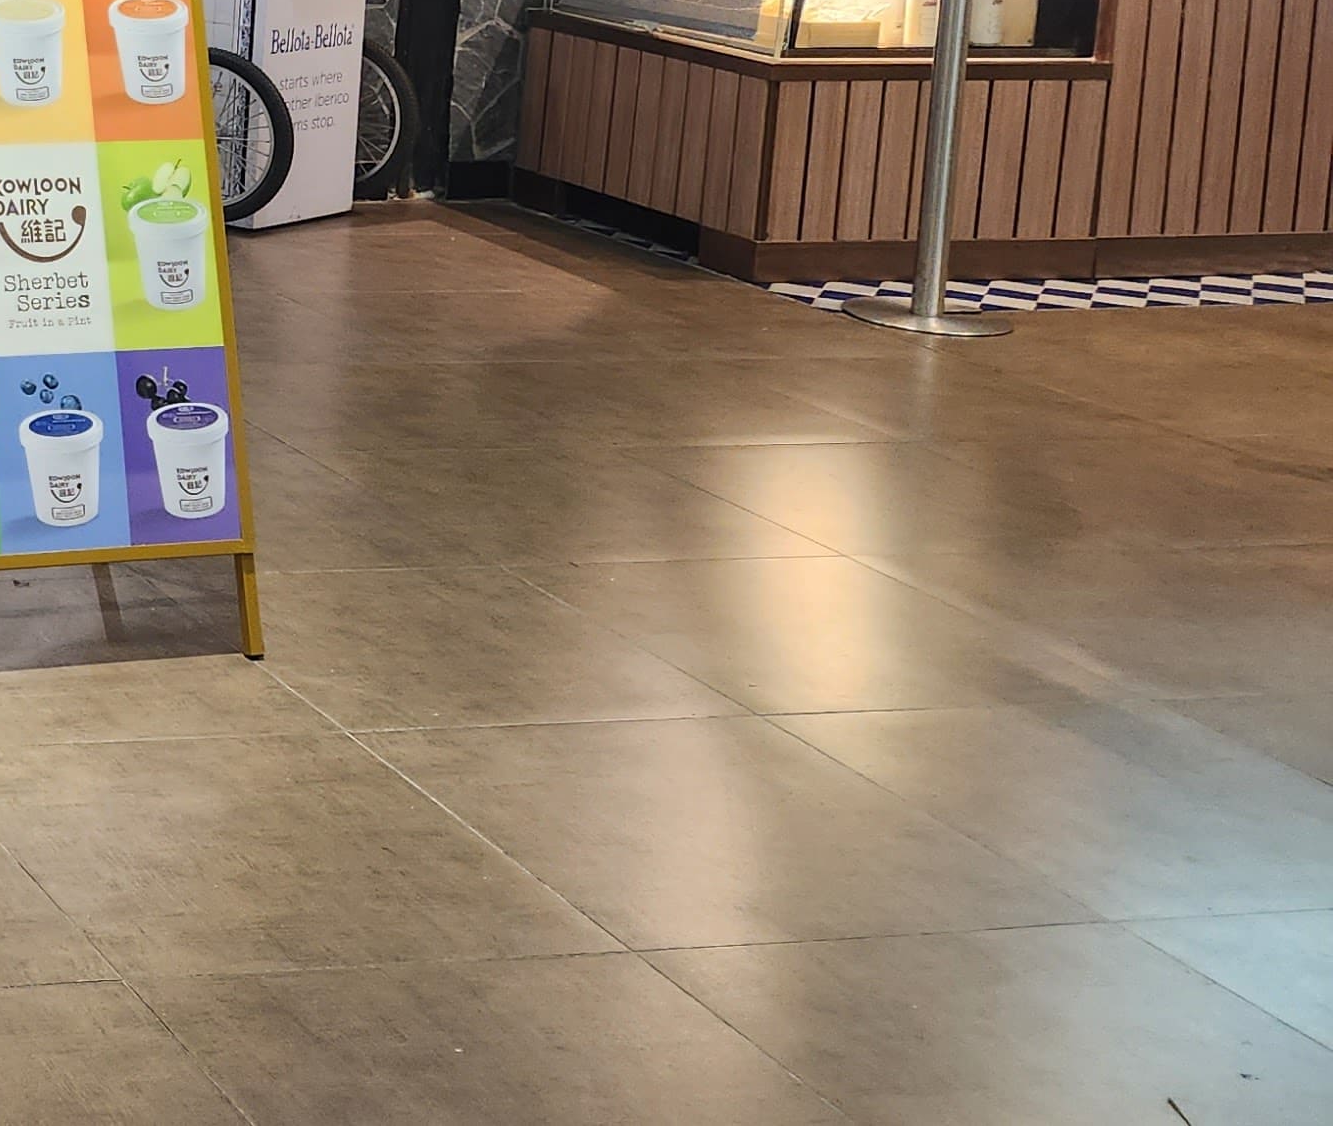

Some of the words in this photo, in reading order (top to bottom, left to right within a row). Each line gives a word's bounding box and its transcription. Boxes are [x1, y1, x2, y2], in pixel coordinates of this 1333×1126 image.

[279, 76, 309, 91] starts
[312, 72, 343, 86] where
[20, 218, 67, 244] 維記
[3, 271, 90, 294] Sherbet
[16, 291, 91, 312] Series
[42, 317, 54, 328] in
[57, 320, 65, 328] a
[67, 315, 93, 328] Pint
